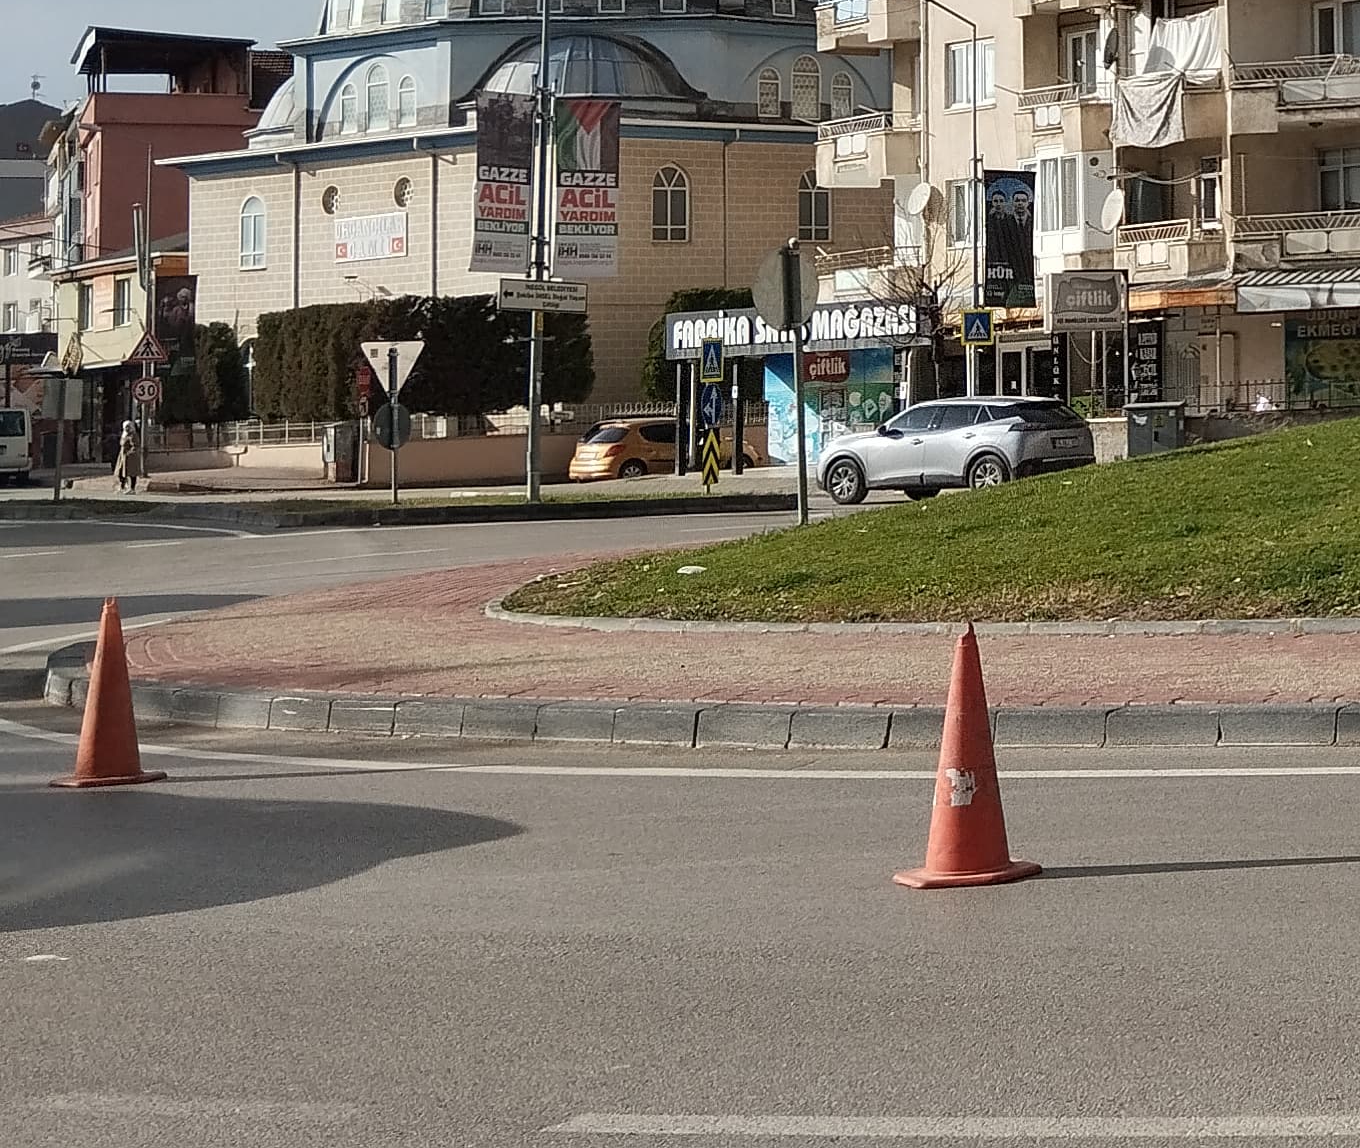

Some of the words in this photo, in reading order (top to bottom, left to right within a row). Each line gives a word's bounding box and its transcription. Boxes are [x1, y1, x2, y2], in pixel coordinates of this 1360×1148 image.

[479, 166, 528, 182] GAZZE
[560, 172, 616, 186] GAZZE
[479, 206, 526, 220] YARDIM
[560, 211, 615, 222] YARDIM
[987, 265, 1014, 279] HÜR
[812, 304, 917, 340] MAĞAZASI
[809, 357, 847, 379] çiftlik
[138, 385, 156, 396] 30
